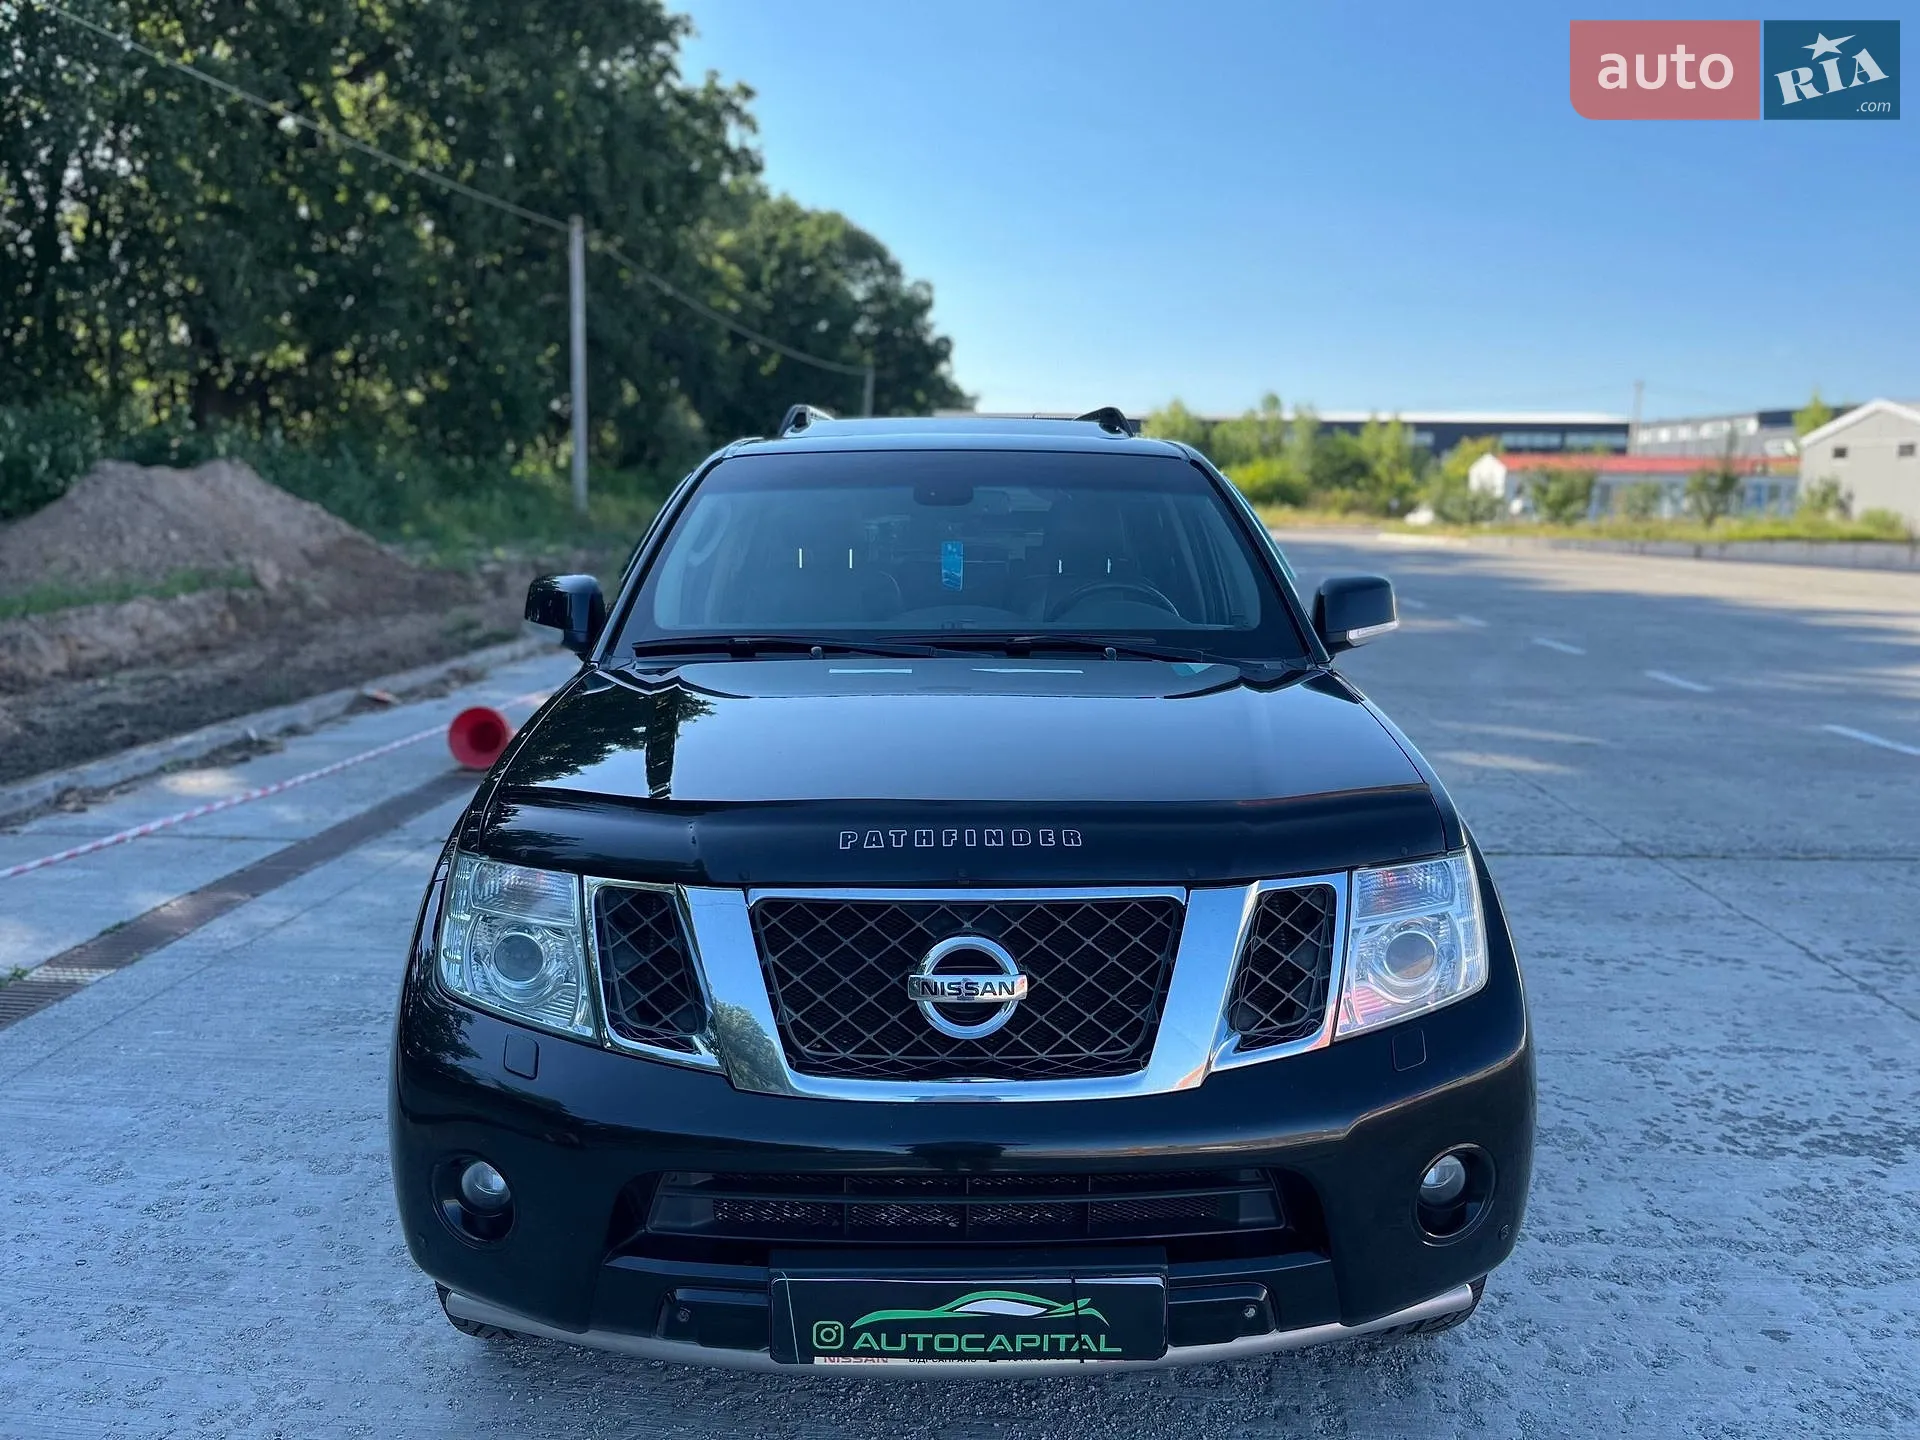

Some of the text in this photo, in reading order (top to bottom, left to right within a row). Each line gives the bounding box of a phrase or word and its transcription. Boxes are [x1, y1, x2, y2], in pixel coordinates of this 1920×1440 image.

[839, 829, 1082, 849] PATHFINDER
[920, 981, 1016, 997] NISSAN
[852, 1332, 1122, 1352] AUTOCAPITAL
